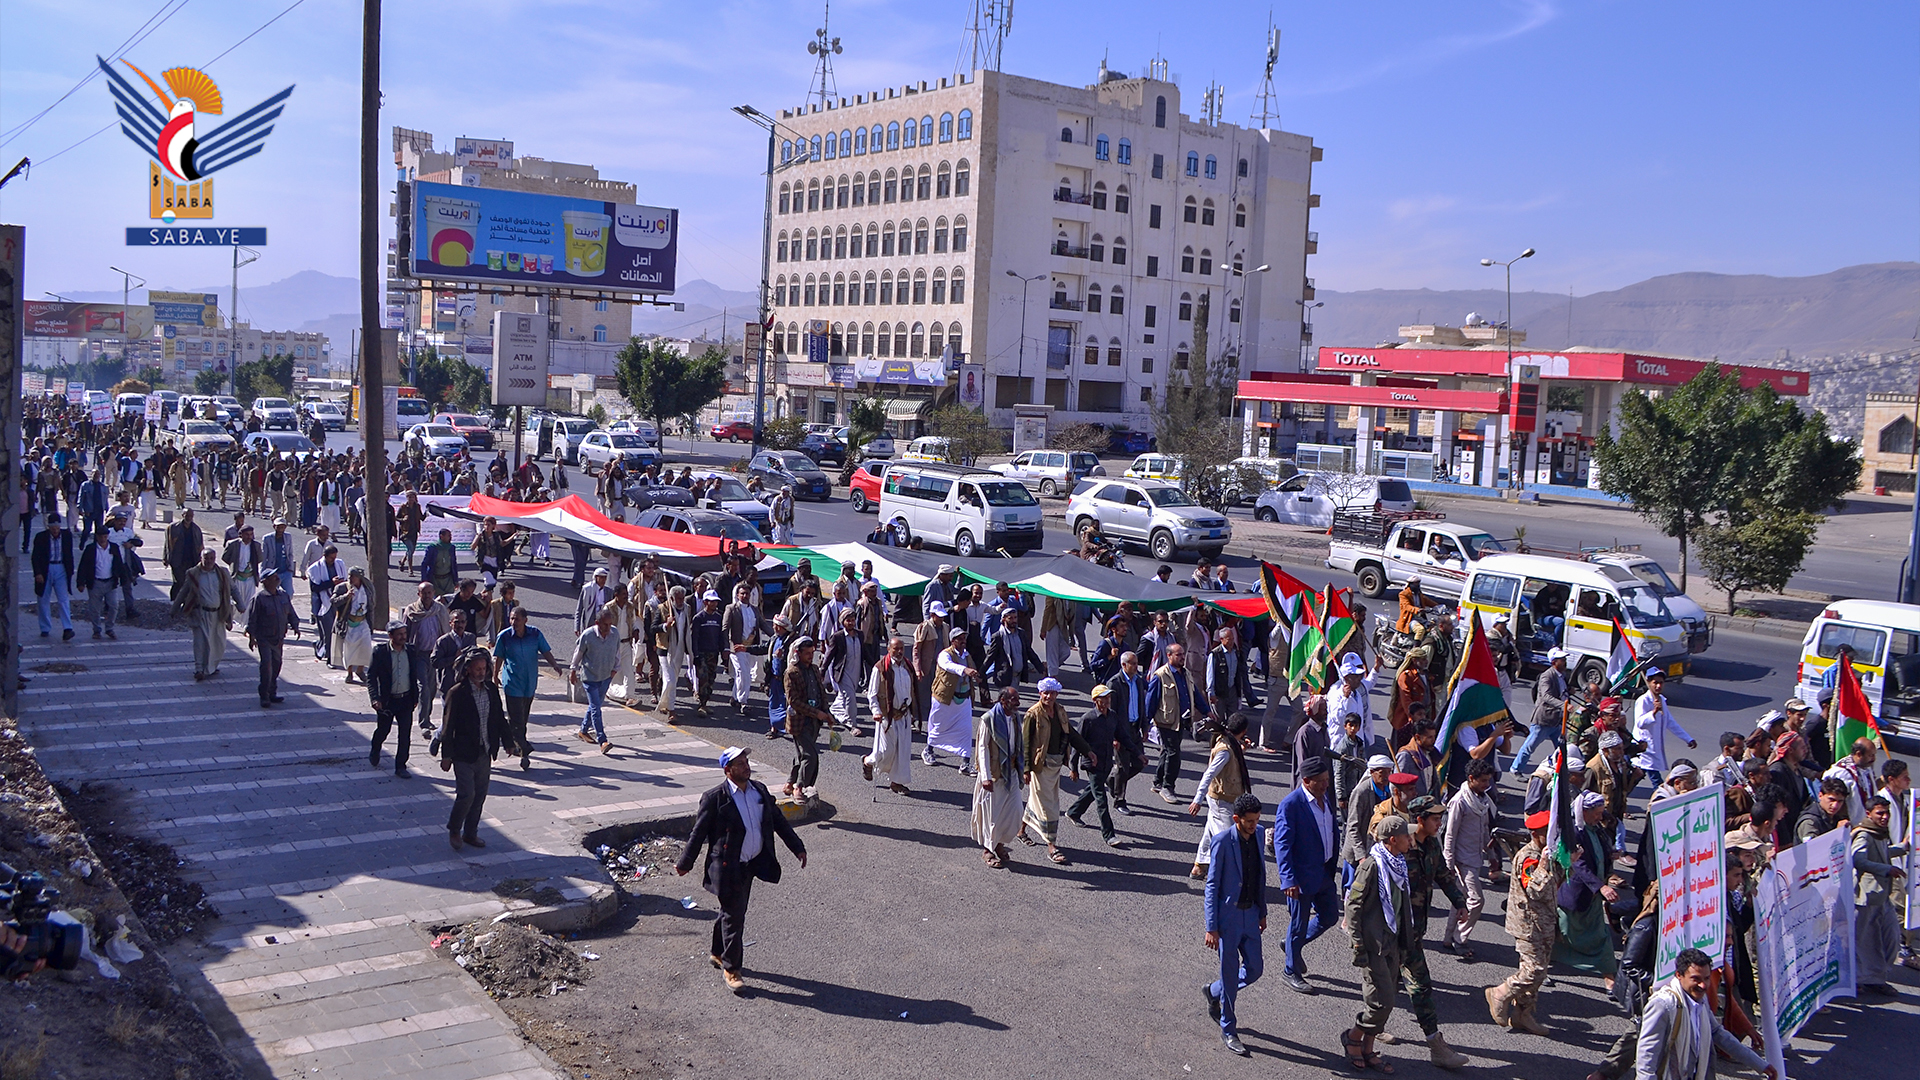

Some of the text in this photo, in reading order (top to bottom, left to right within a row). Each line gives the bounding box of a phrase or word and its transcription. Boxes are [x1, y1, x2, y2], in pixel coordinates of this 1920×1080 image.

[456, 141, 511, 160] برج اليمن الطبي
[617, 214, 670, 234] أورينت
[632, 252, 652, 267] أصل
[620, 270, 662, 283] الدهانات
[513, 354, 533, 362] ATM
[1333, 352, 1380, 366] TOTAL
[1635, 360, 1670, 376] TOTAL
[1390, 392, 1418, 401] TOTAL
[1658, 806, 1691, 854] أكبر
[1689, 840, 1717, 866] الموت
[1690, 869, 1719, 894] الموت
[1662, 896, 1719, 938] اللعنة على اليهود
[1692, 922, 1719, 950] النصر
